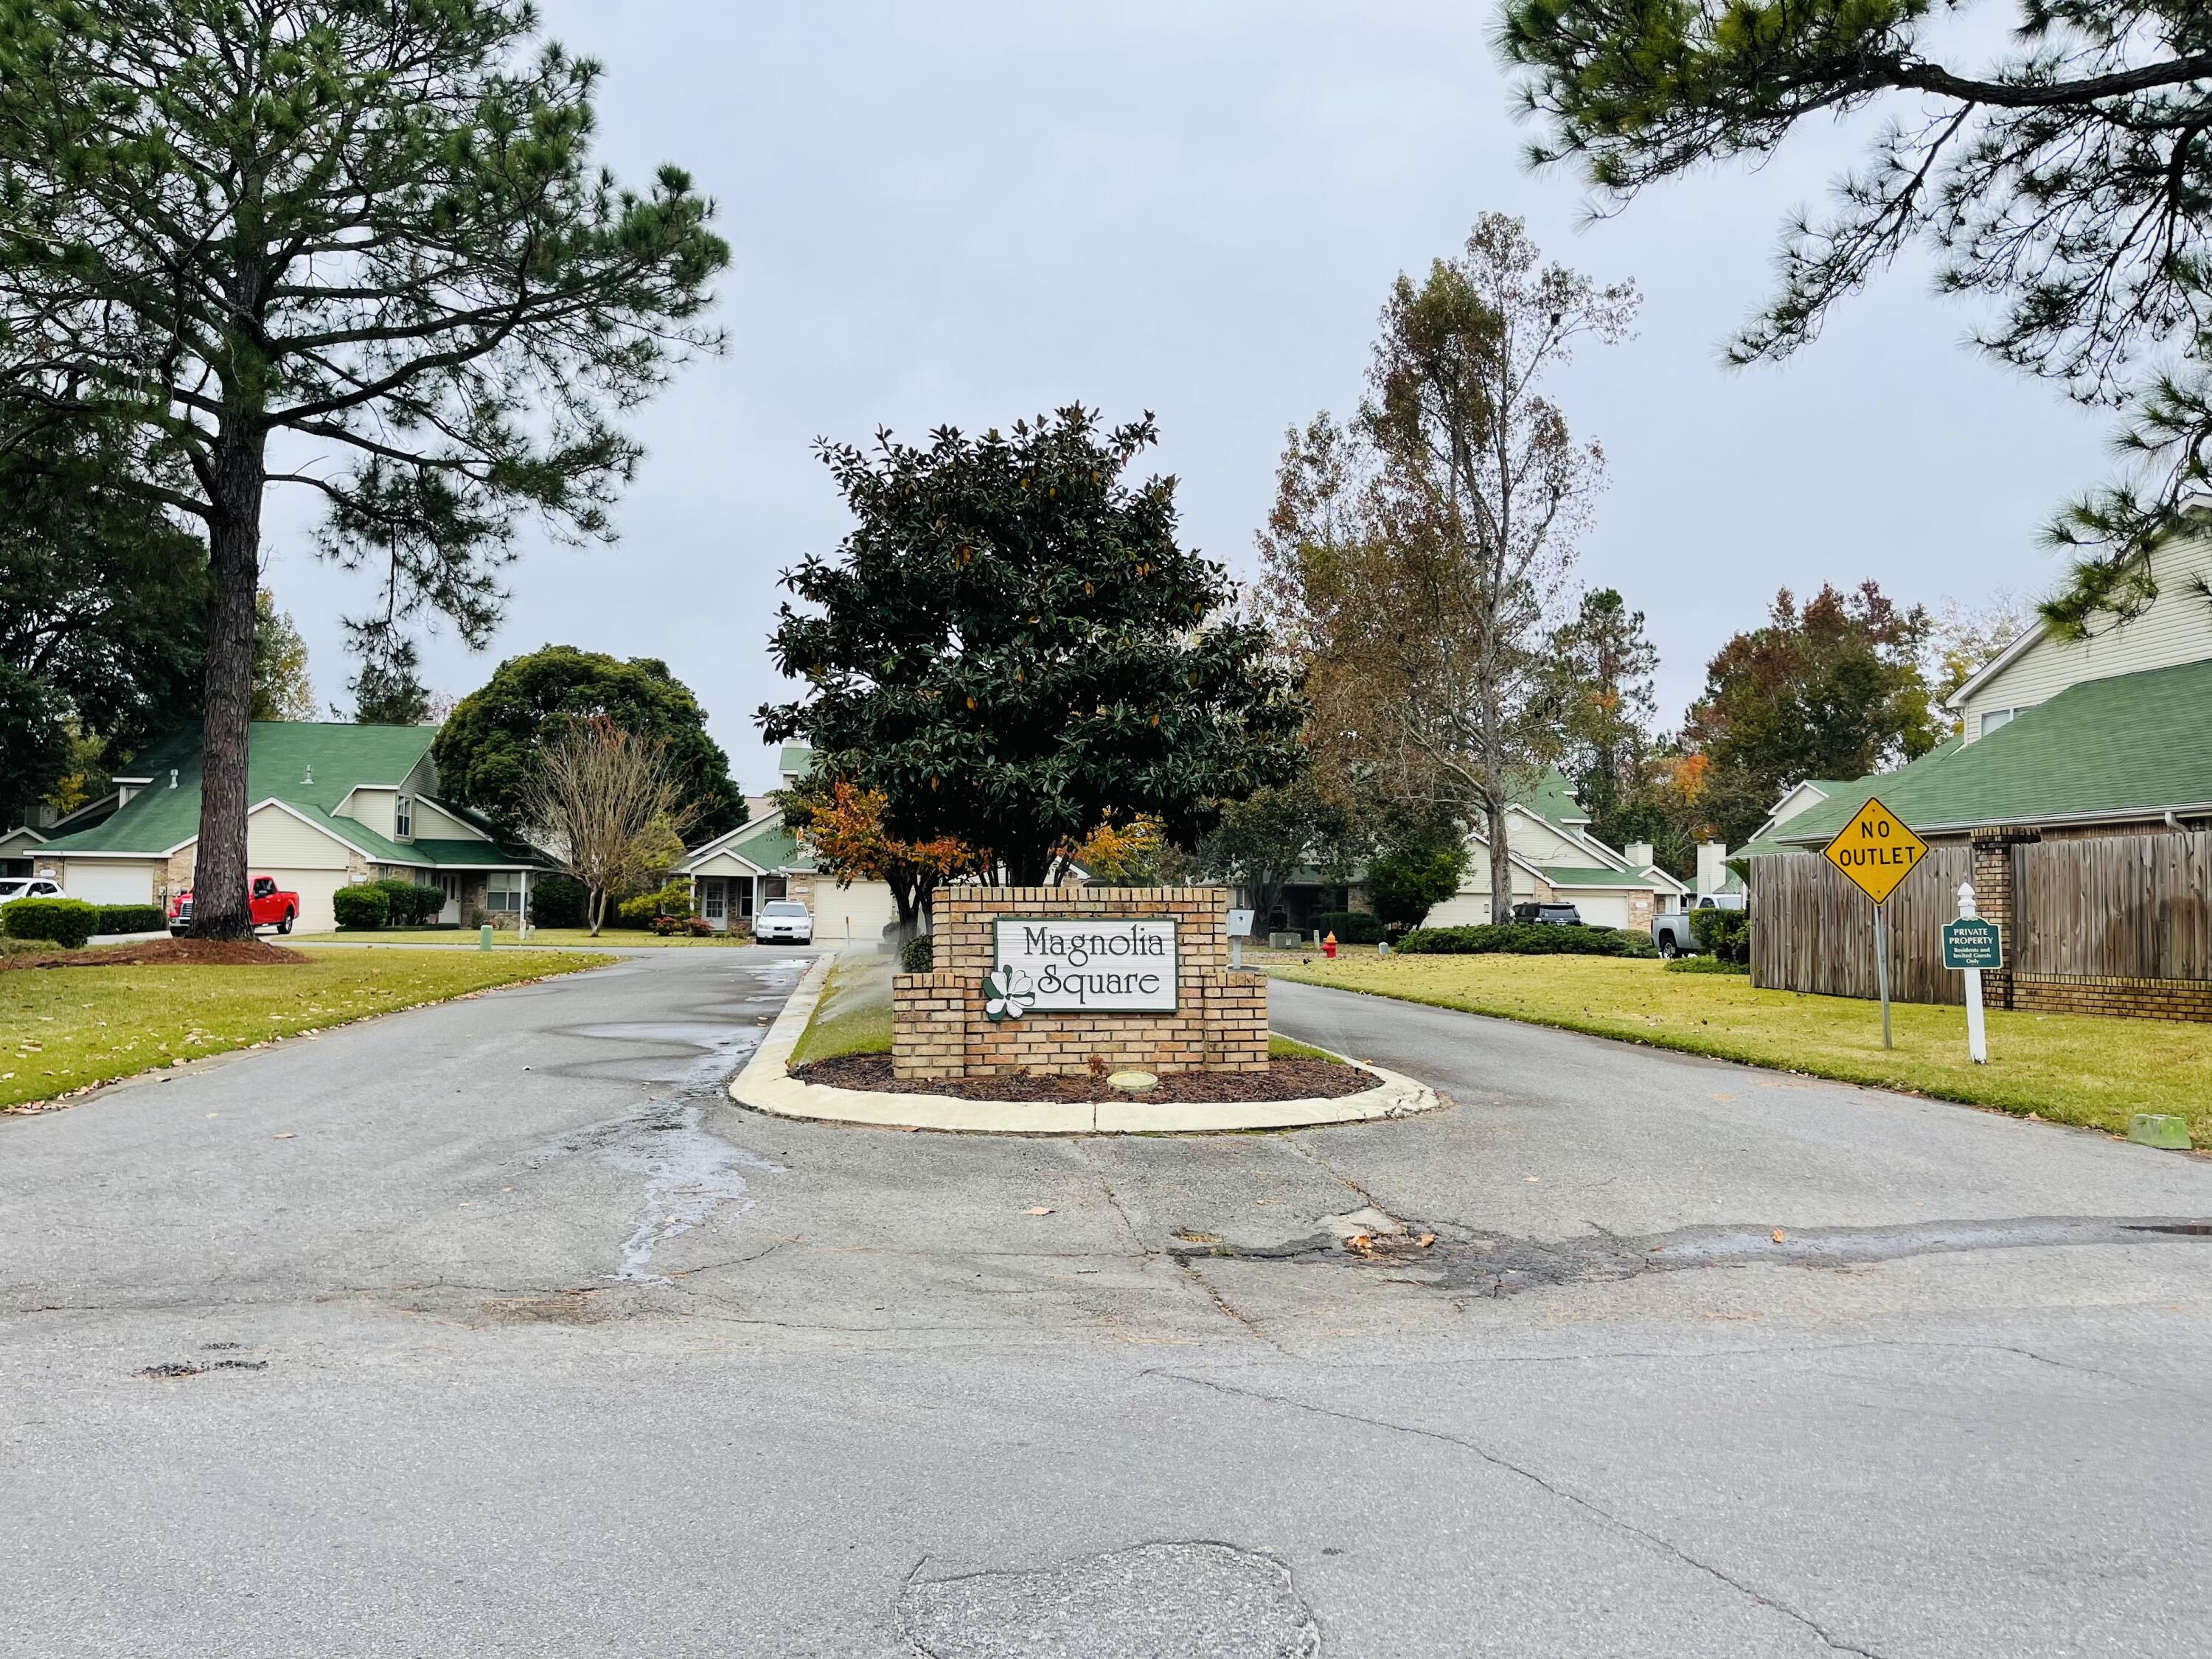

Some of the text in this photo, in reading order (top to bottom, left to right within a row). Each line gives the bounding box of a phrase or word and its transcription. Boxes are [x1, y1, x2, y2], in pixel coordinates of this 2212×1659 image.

[1861, 821, 1890, 838] NO
[1840, 846, 1915, 866] OUTLET
[1023, 923, 1165, 967] Magnolia
[1037, 964, 1160, 1004] Square
